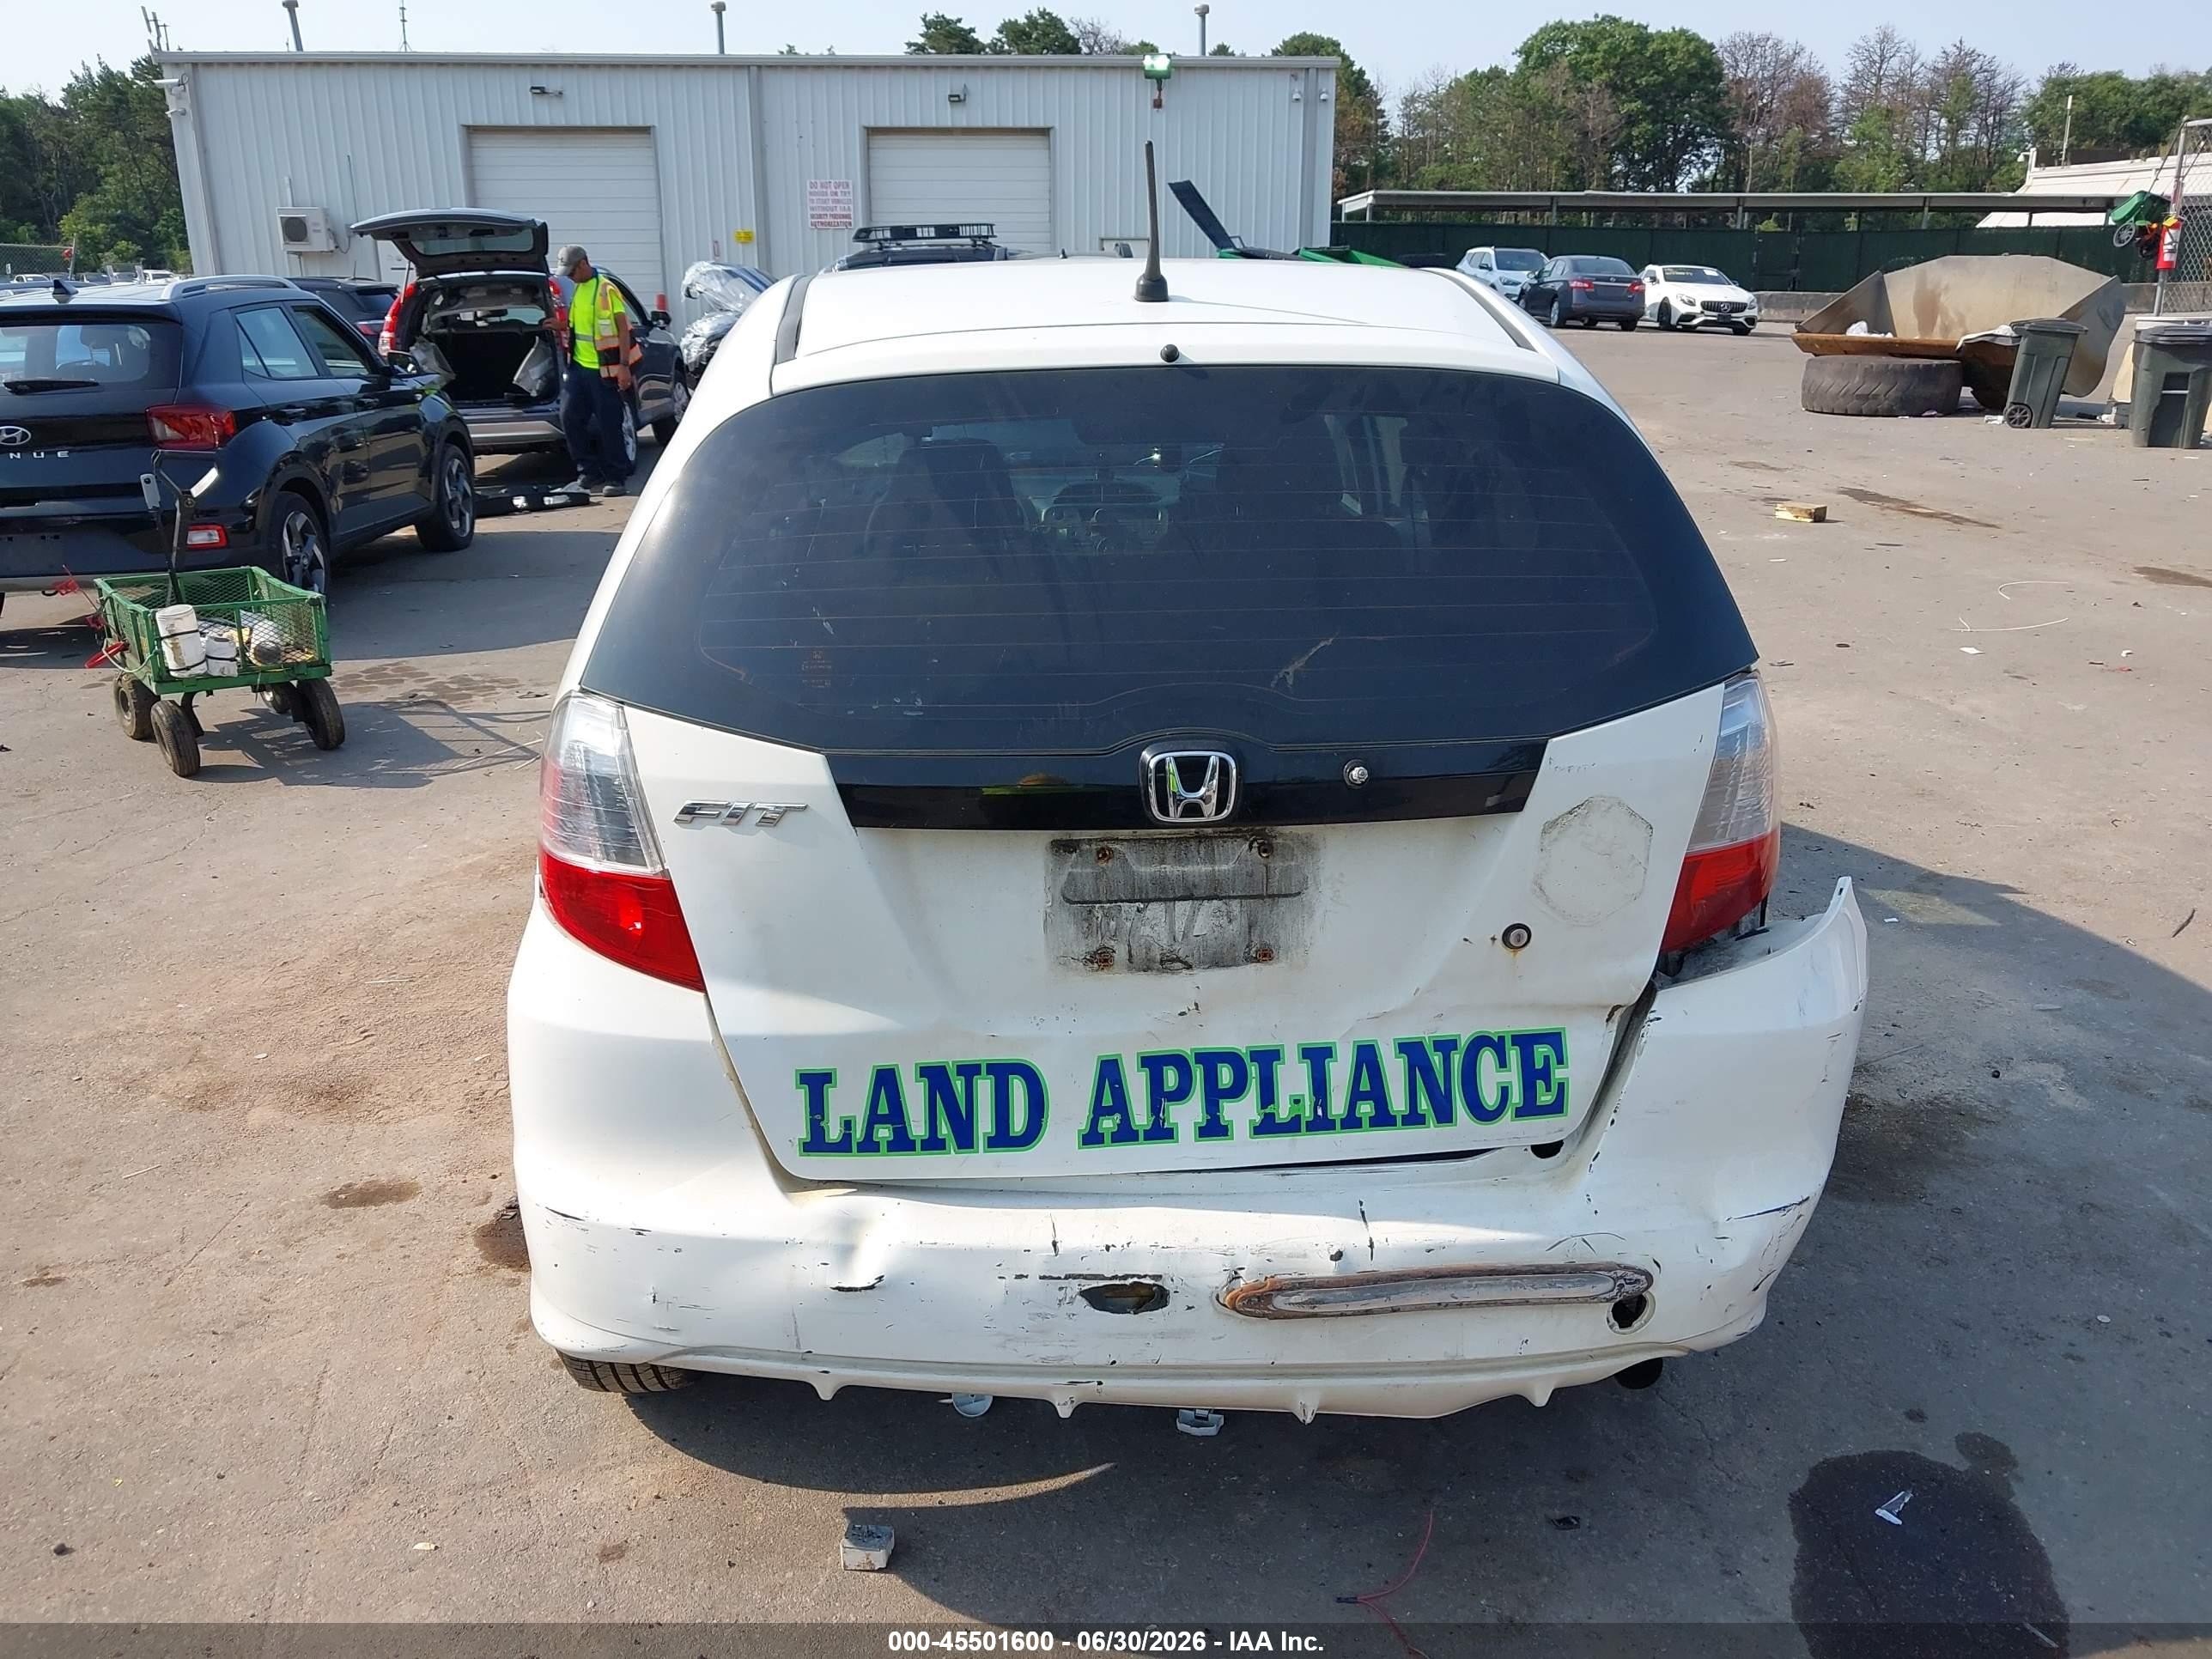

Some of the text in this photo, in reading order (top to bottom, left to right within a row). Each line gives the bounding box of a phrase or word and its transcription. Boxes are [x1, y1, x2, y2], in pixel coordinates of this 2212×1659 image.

[672, 799, 810, 827] FIT
[795, 1026, 1570, 1158] LAND APPLIANCE
